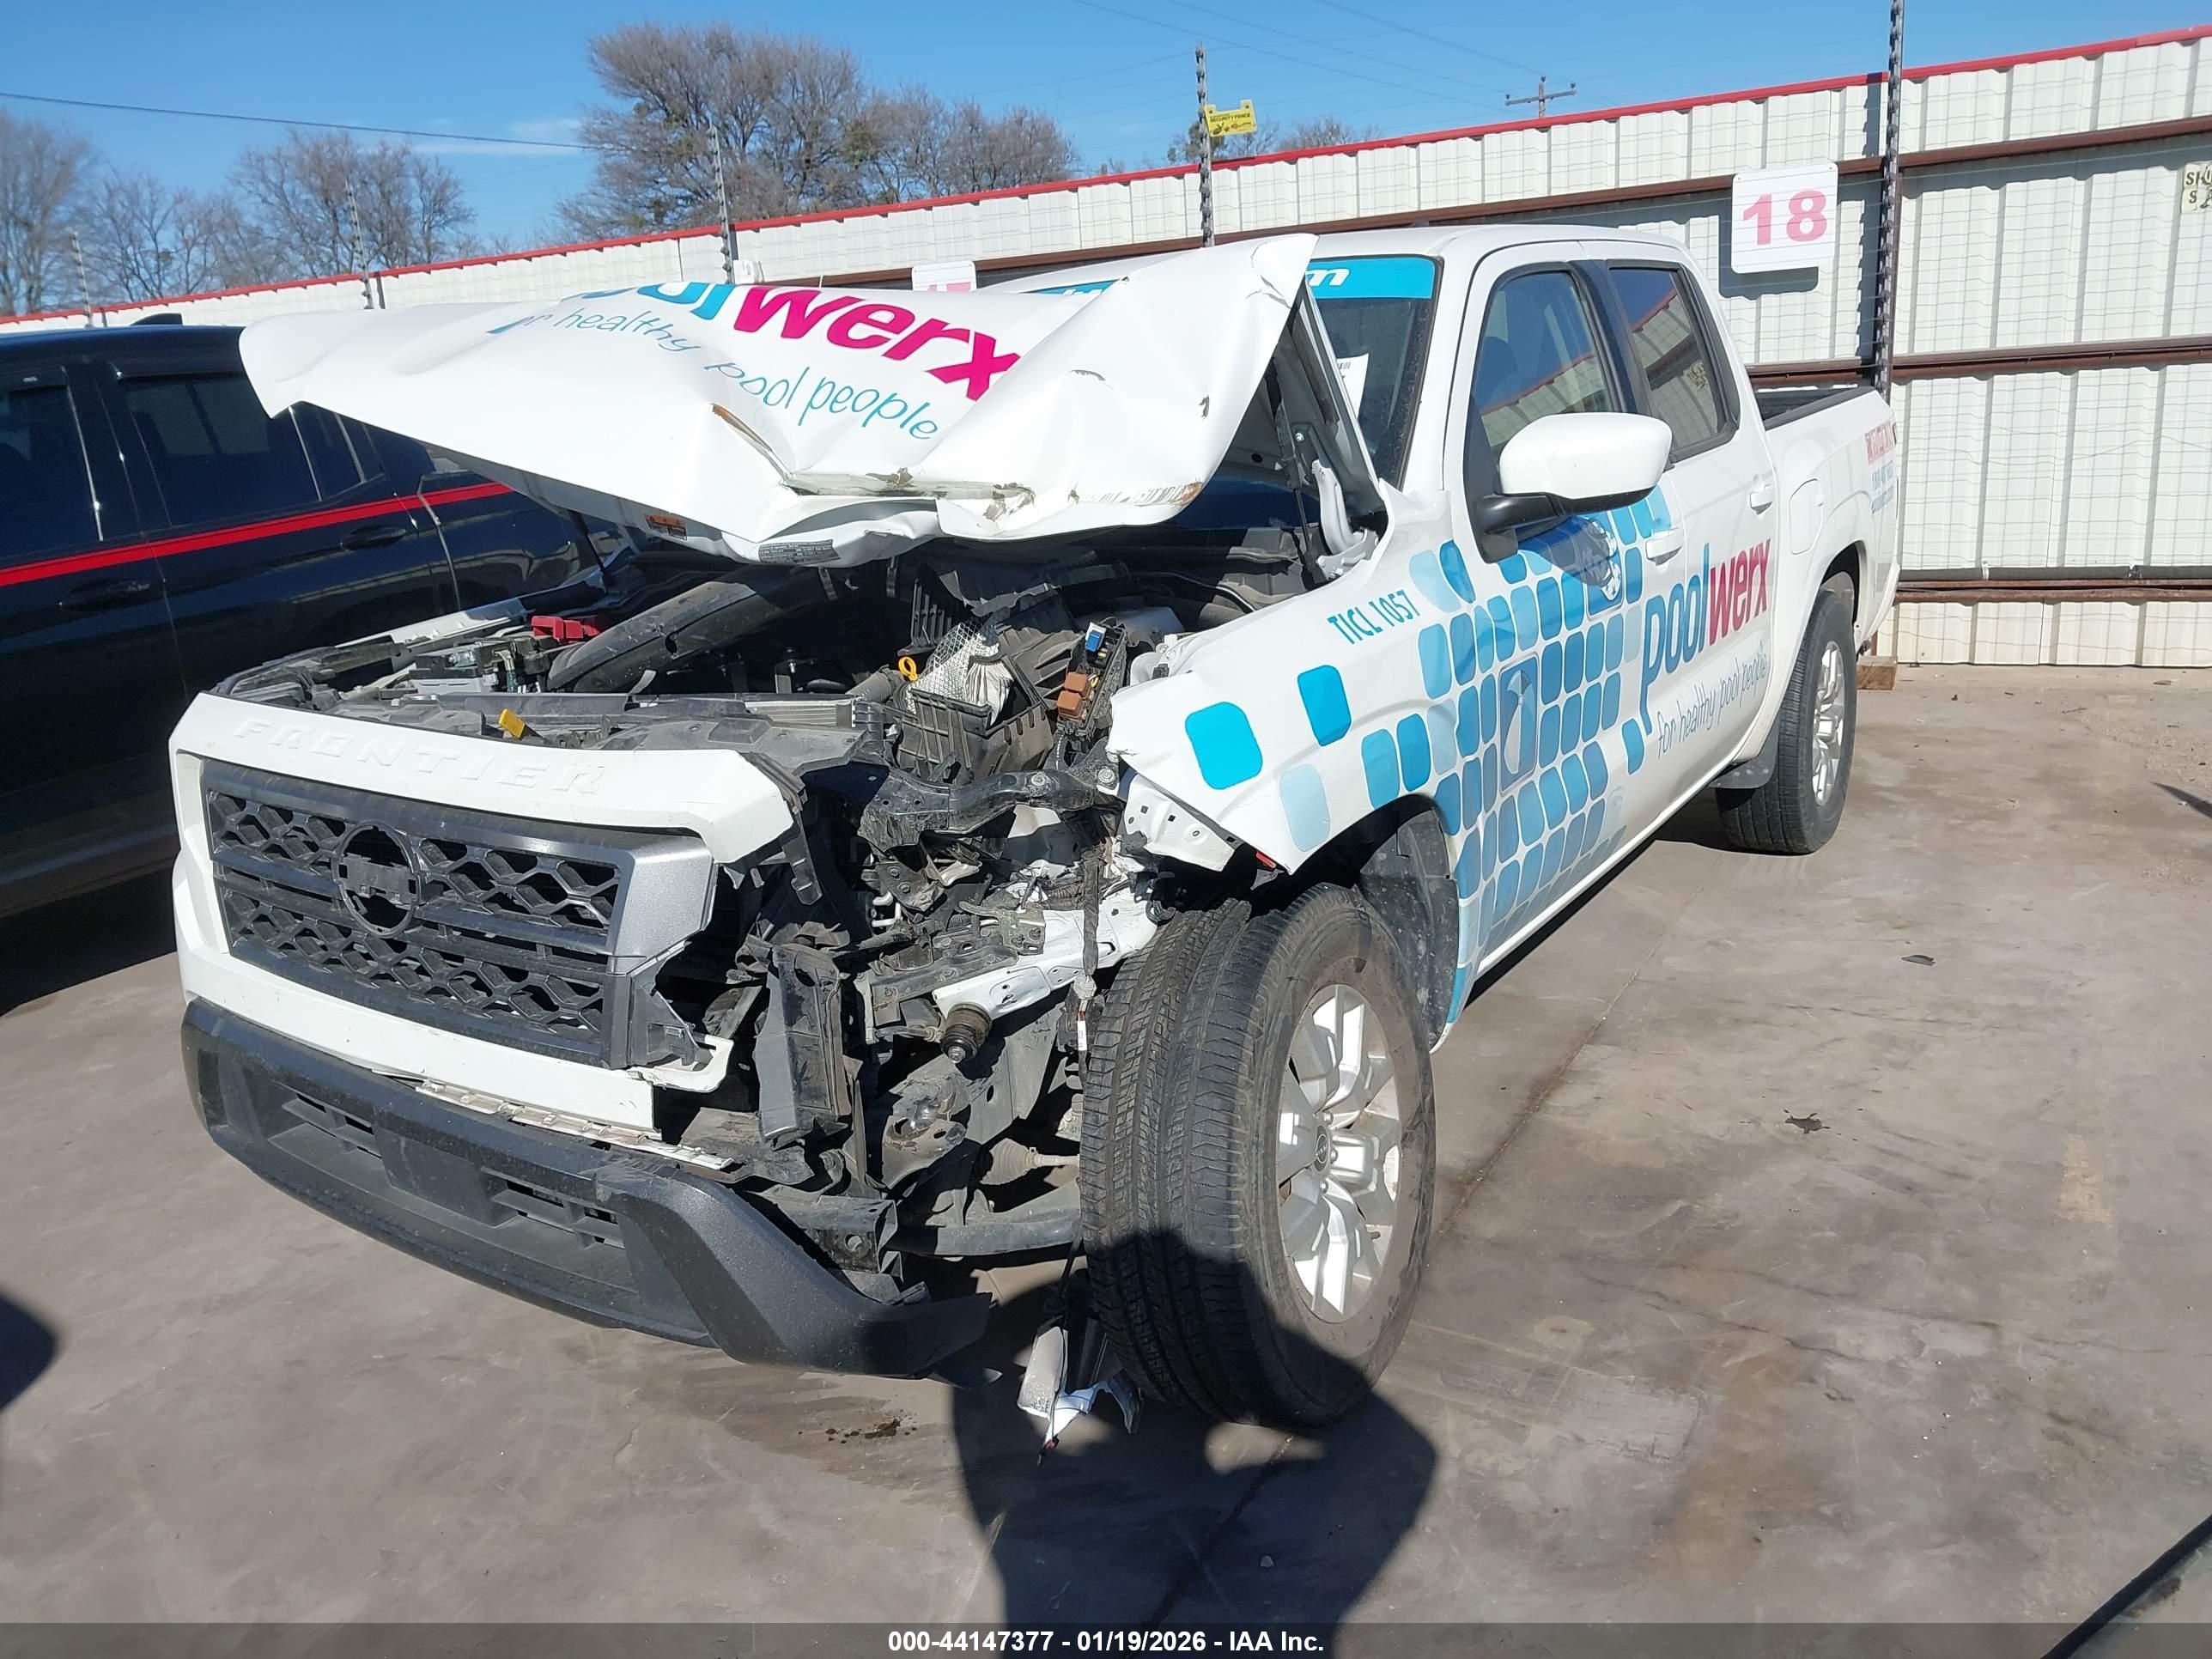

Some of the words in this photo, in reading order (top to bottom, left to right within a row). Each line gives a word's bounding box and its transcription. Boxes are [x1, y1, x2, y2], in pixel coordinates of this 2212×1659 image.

[1743, 190, 1827, 246] 18
[553, 307, 702, 351] healthy
[703, 362, 810, 410] pool
[798, 376, 939, 440] people
[1327, 606, 1383, 644] TICL
[1368, 589, 1420, 627] 1057
[1639, 538, 1771, 736] poolwerx
[1657, 711, 1674, 759] for
[1676, 683, 1716, 744] healthy
[1717, 658, 1740, 726] pool
[1739, 641, 1768, 708] people
[233, 718, 606, 794] FRONTIER
